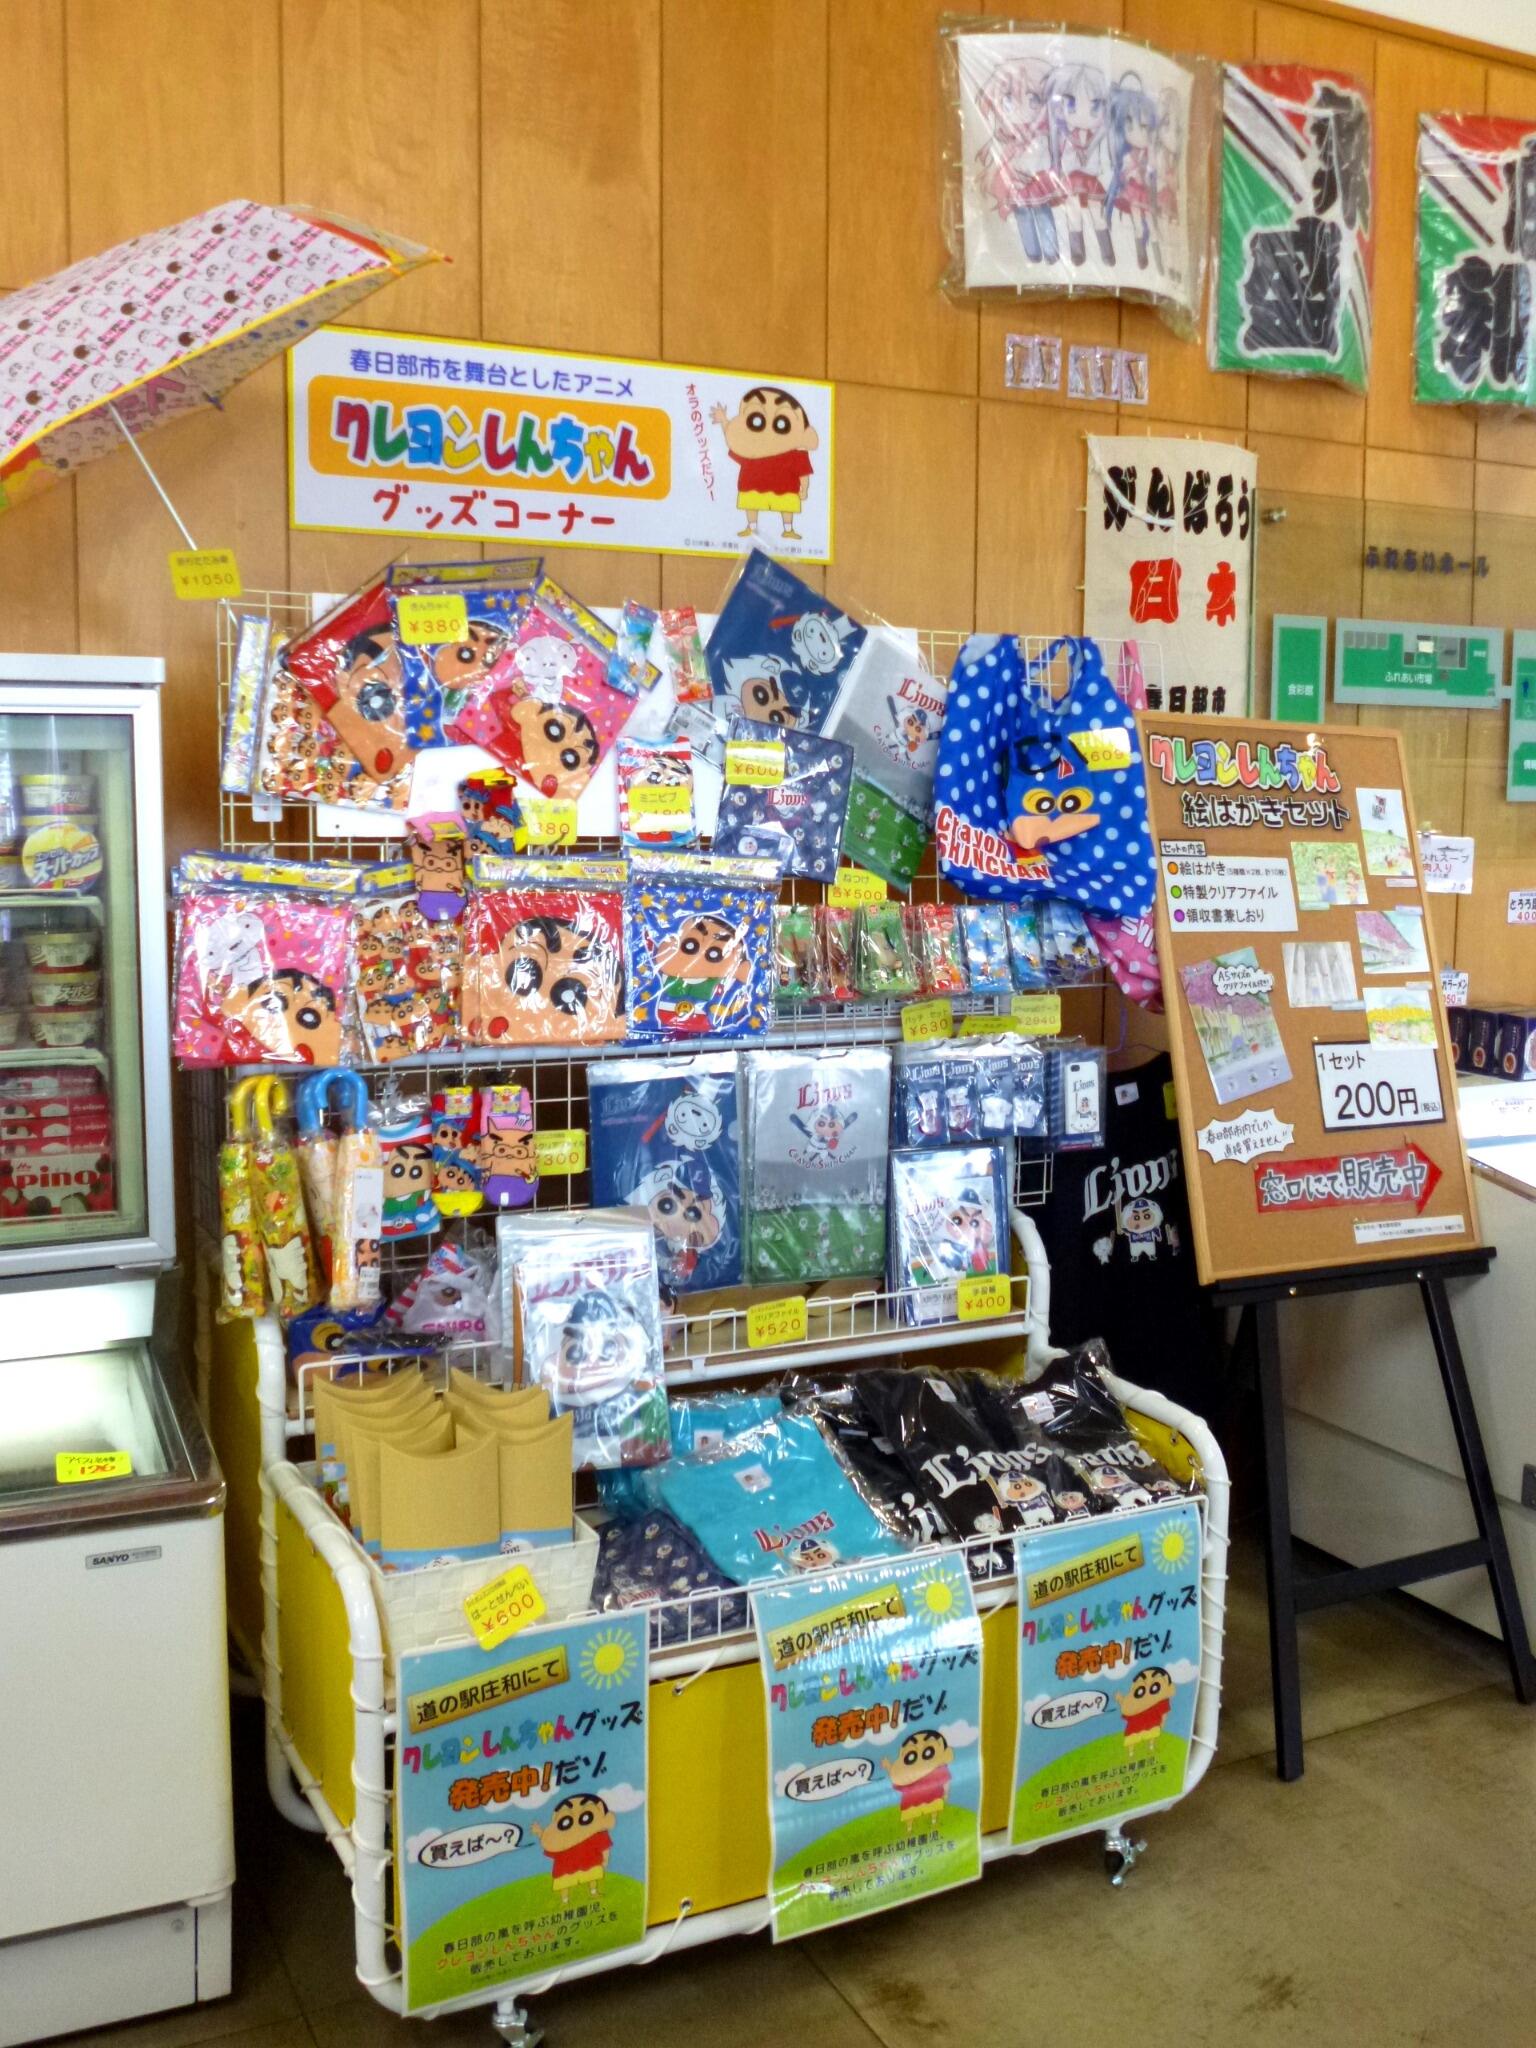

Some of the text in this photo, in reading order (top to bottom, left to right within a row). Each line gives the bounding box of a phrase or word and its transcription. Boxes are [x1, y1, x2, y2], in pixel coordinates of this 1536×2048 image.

[349, 348, 634, 398] 春日部市を舞台としたアニメ
[336, 400, 650, 483] クレヨンしんちゃん
[373, 484, 616, 535] グッズコーナー
[181, 572, 235, 586] ¥1050
[1129, 557, 1237, 627] 日本
[408, 618, 461, 634] ¥380
[896, 677, 948, 717] Lions
[1150, 733, 1341, 793] クレヨンしんちゃん
[937, 806, 1009, 858] Crayon
[1182, 792, 1350, 830] 絵はがきセット
[937, 831, 1050, 881] SHINCHAN
[1179, 861, 1226, 876] 絵はがき
[1183, 884, 1279, 900] 特製クリアファイル
[1186, 908, 1265, 923] 領収書兼しおり
[909, 1018, 949, 1037] ¥630
[1317, 1051, 1366, 1073] 1セット
[1334, 1081, 1419, 1120] 200円
[16, 1165, 100, 1190] pino
[1259, 1152, 1430, 1208] 窓口にて販売中
[964, 1295, 1006, 1311] ¥400
[755, 1318, 801, 1338] ¥520
[753, 1510, 838, 1553] Lions
[92, 1553, 130, 1566] SANYO
[1032, 1546, 1138, 1601] 道の駅庄和にて
[481, 1593, 534, 1631] ¥600
[776, 1596, 899, 1662] 道の駅庄和にて
[1022, 1584, 1198, 1646] クレヨンしんちゃんグッズ
[1055, 1629, 1173, 1680] 発売中!だゾ
[416, 1658, 562, 1725] 道の駅庄和にて
[402, 1701, 644, 1774] クレヨンしんちゃんグッズ
[811, 1689, 948, 1749] 発売中!だゾ
[448, 1751, 607, 1811] 発売中!だゾ
